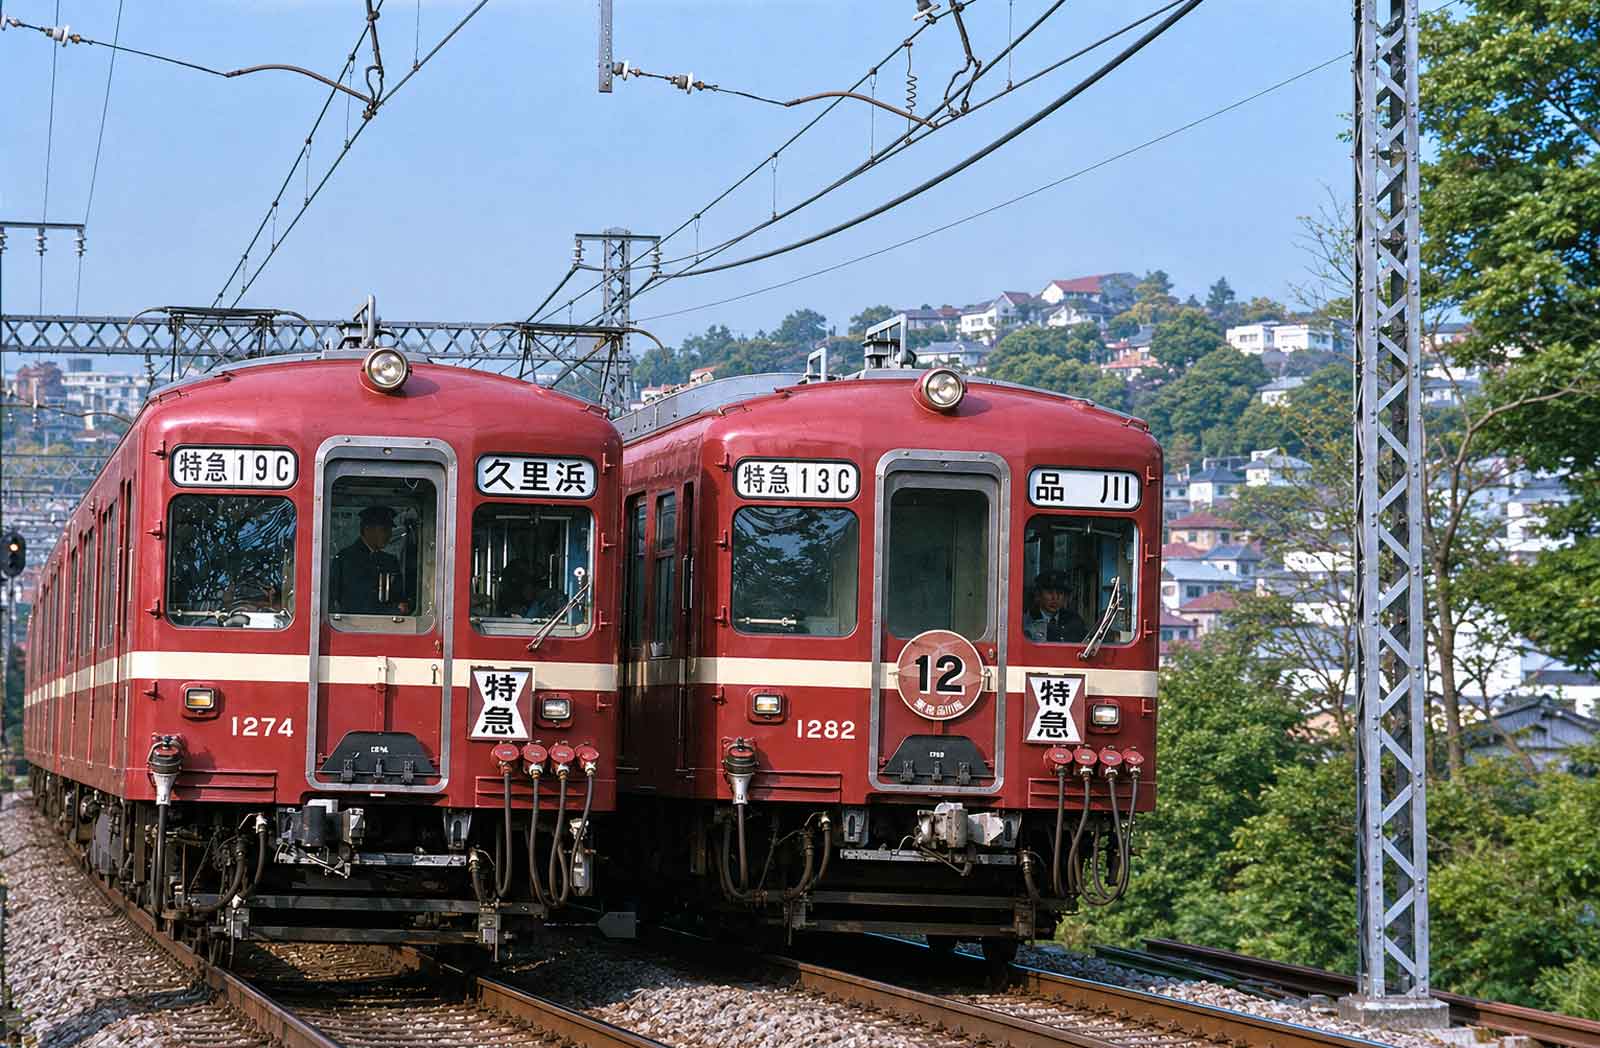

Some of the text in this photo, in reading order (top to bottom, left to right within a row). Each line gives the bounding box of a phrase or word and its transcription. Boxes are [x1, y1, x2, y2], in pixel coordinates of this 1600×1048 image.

[179, 451, 289, 482] 特急19C
[483, 459, 586, 493] 久里浜
[743, 464, 850, 494] 特急13C
[1036, 472, 1130, 504] 品川
[914, 654, 966, 696] 12
[481, 673, 517, 735] 特急
[1037, 679, 1071, 738] 特急
[231, 716, 294, 737] 1274
[796, 719, 856, 740] 1282
